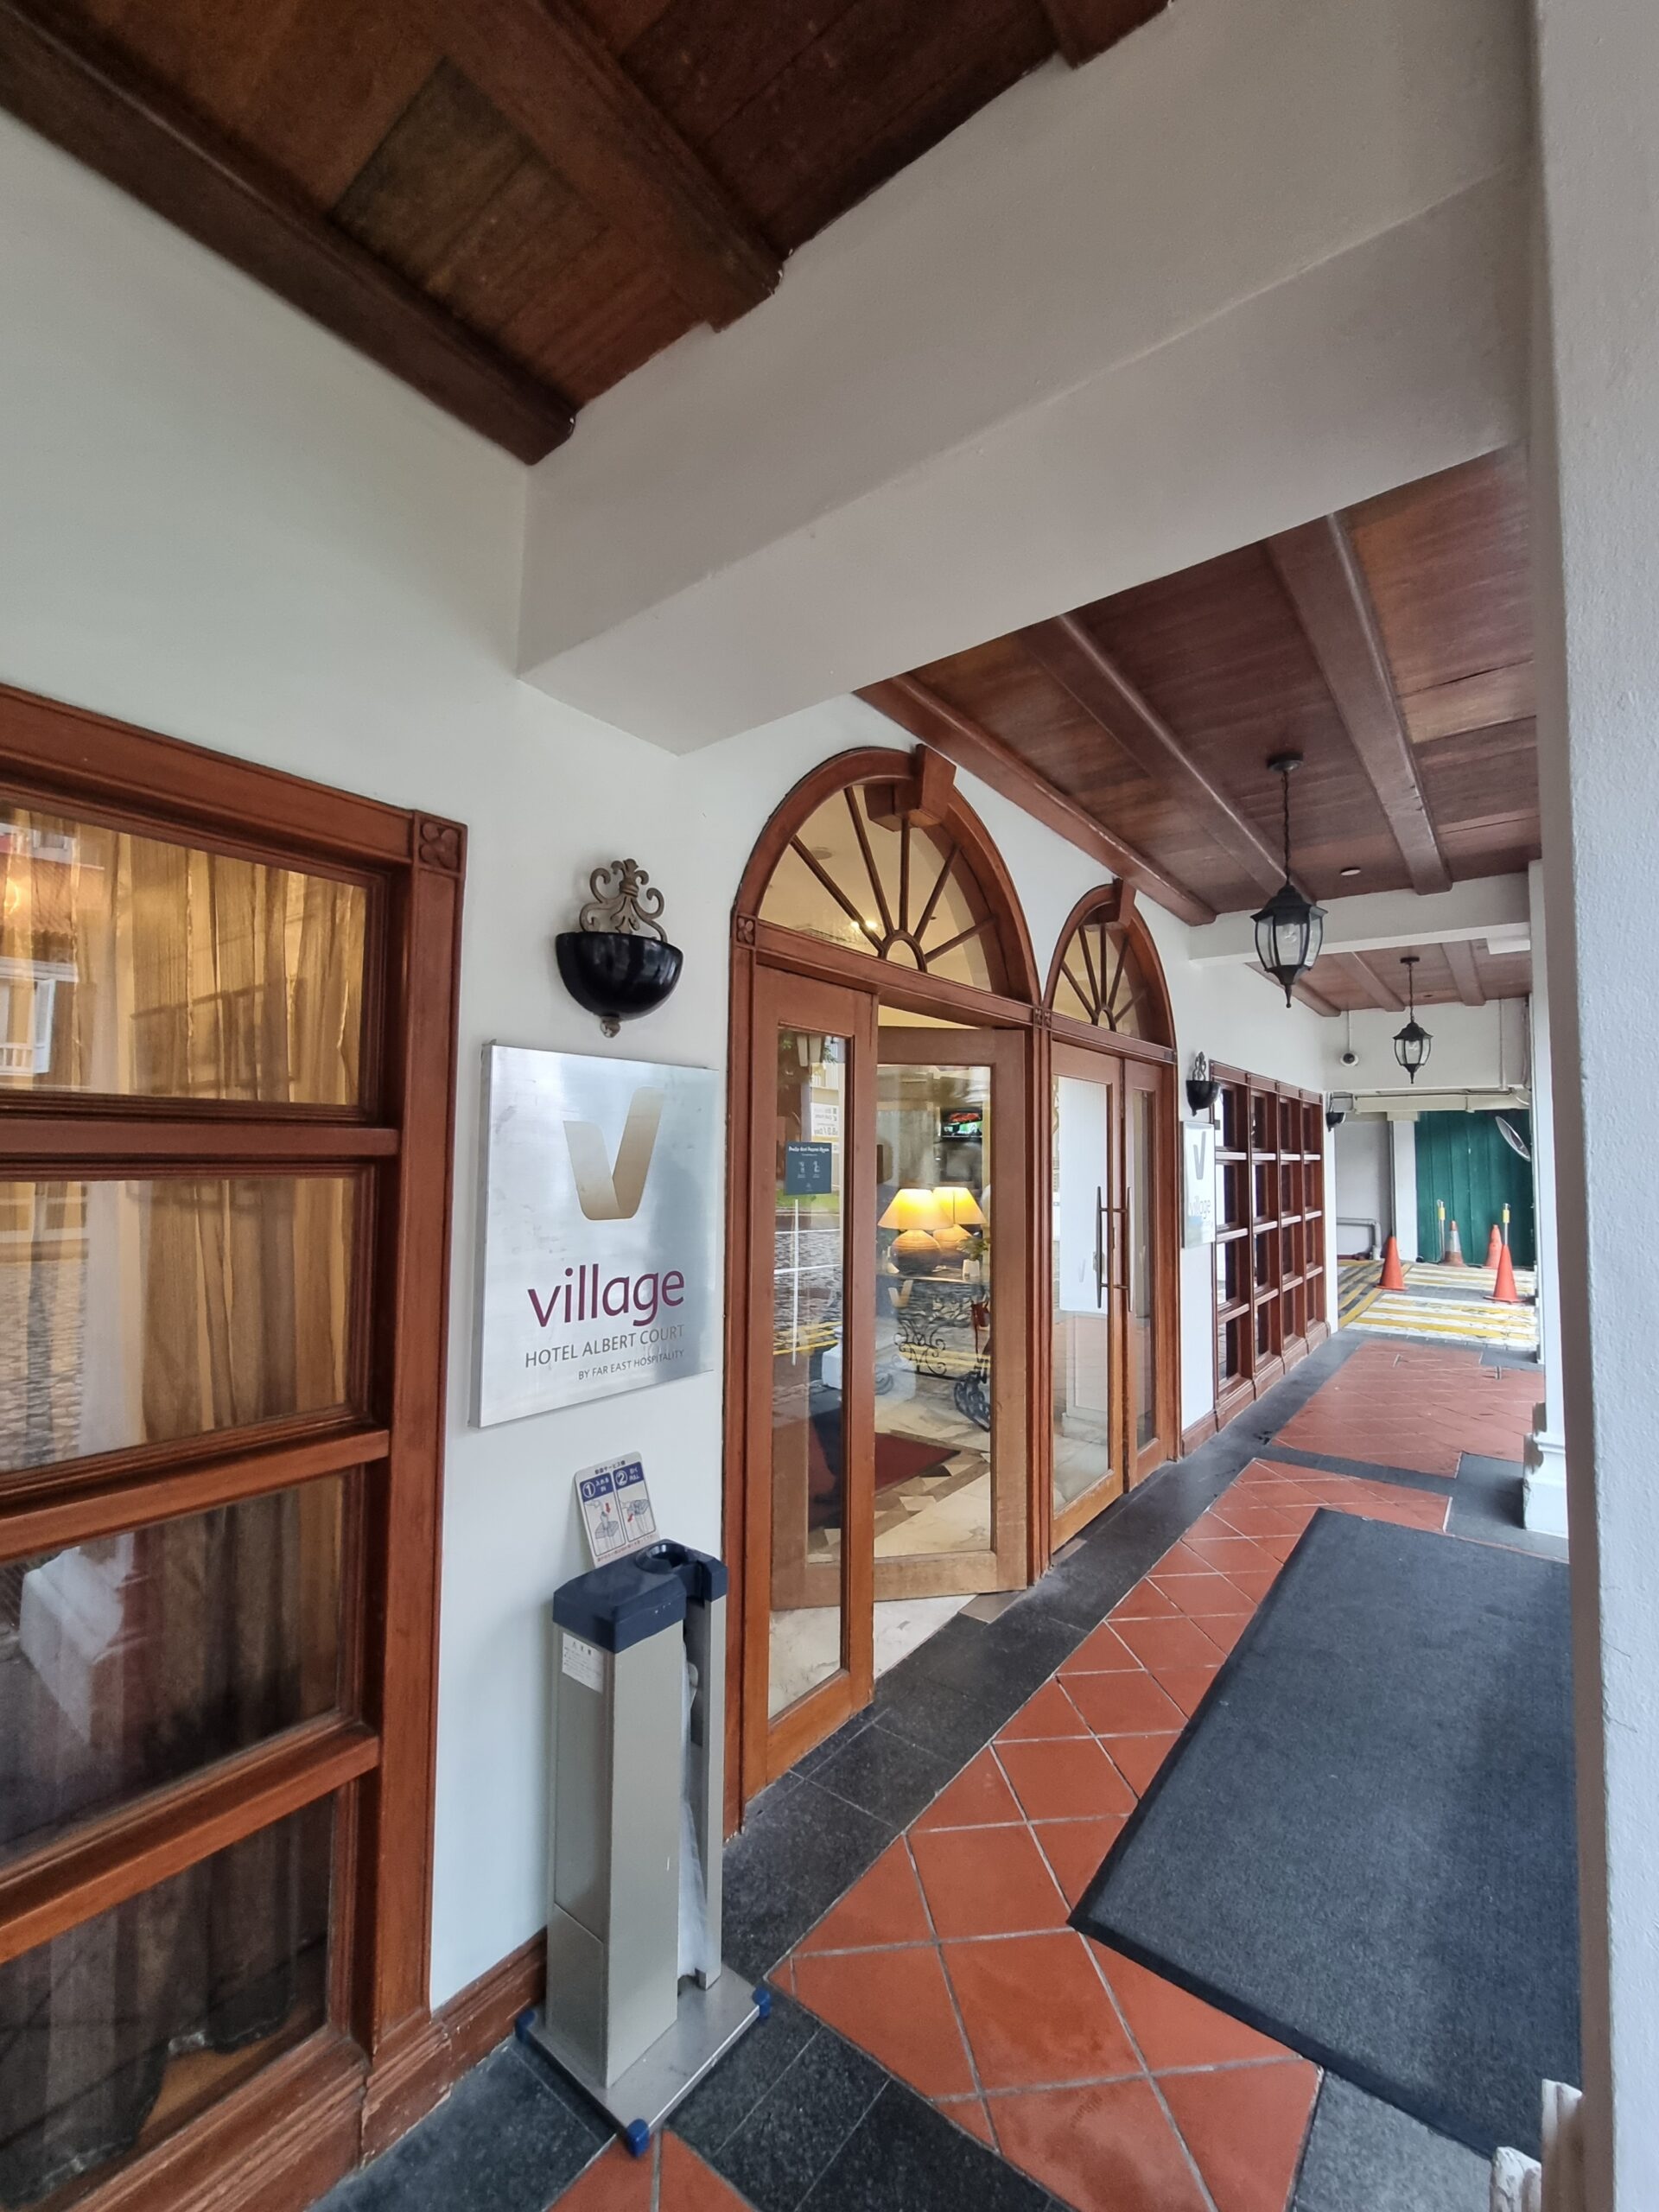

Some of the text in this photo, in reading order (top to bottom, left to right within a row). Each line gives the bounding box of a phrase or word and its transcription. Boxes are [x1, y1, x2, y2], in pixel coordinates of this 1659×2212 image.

[527, 1263, 685, 1328] village
[525, 1324, 685, 1368] HOTEL ALBERT COURT
[578, 1349, 685, 1381] BY FAR EAST HOSPITALITY
